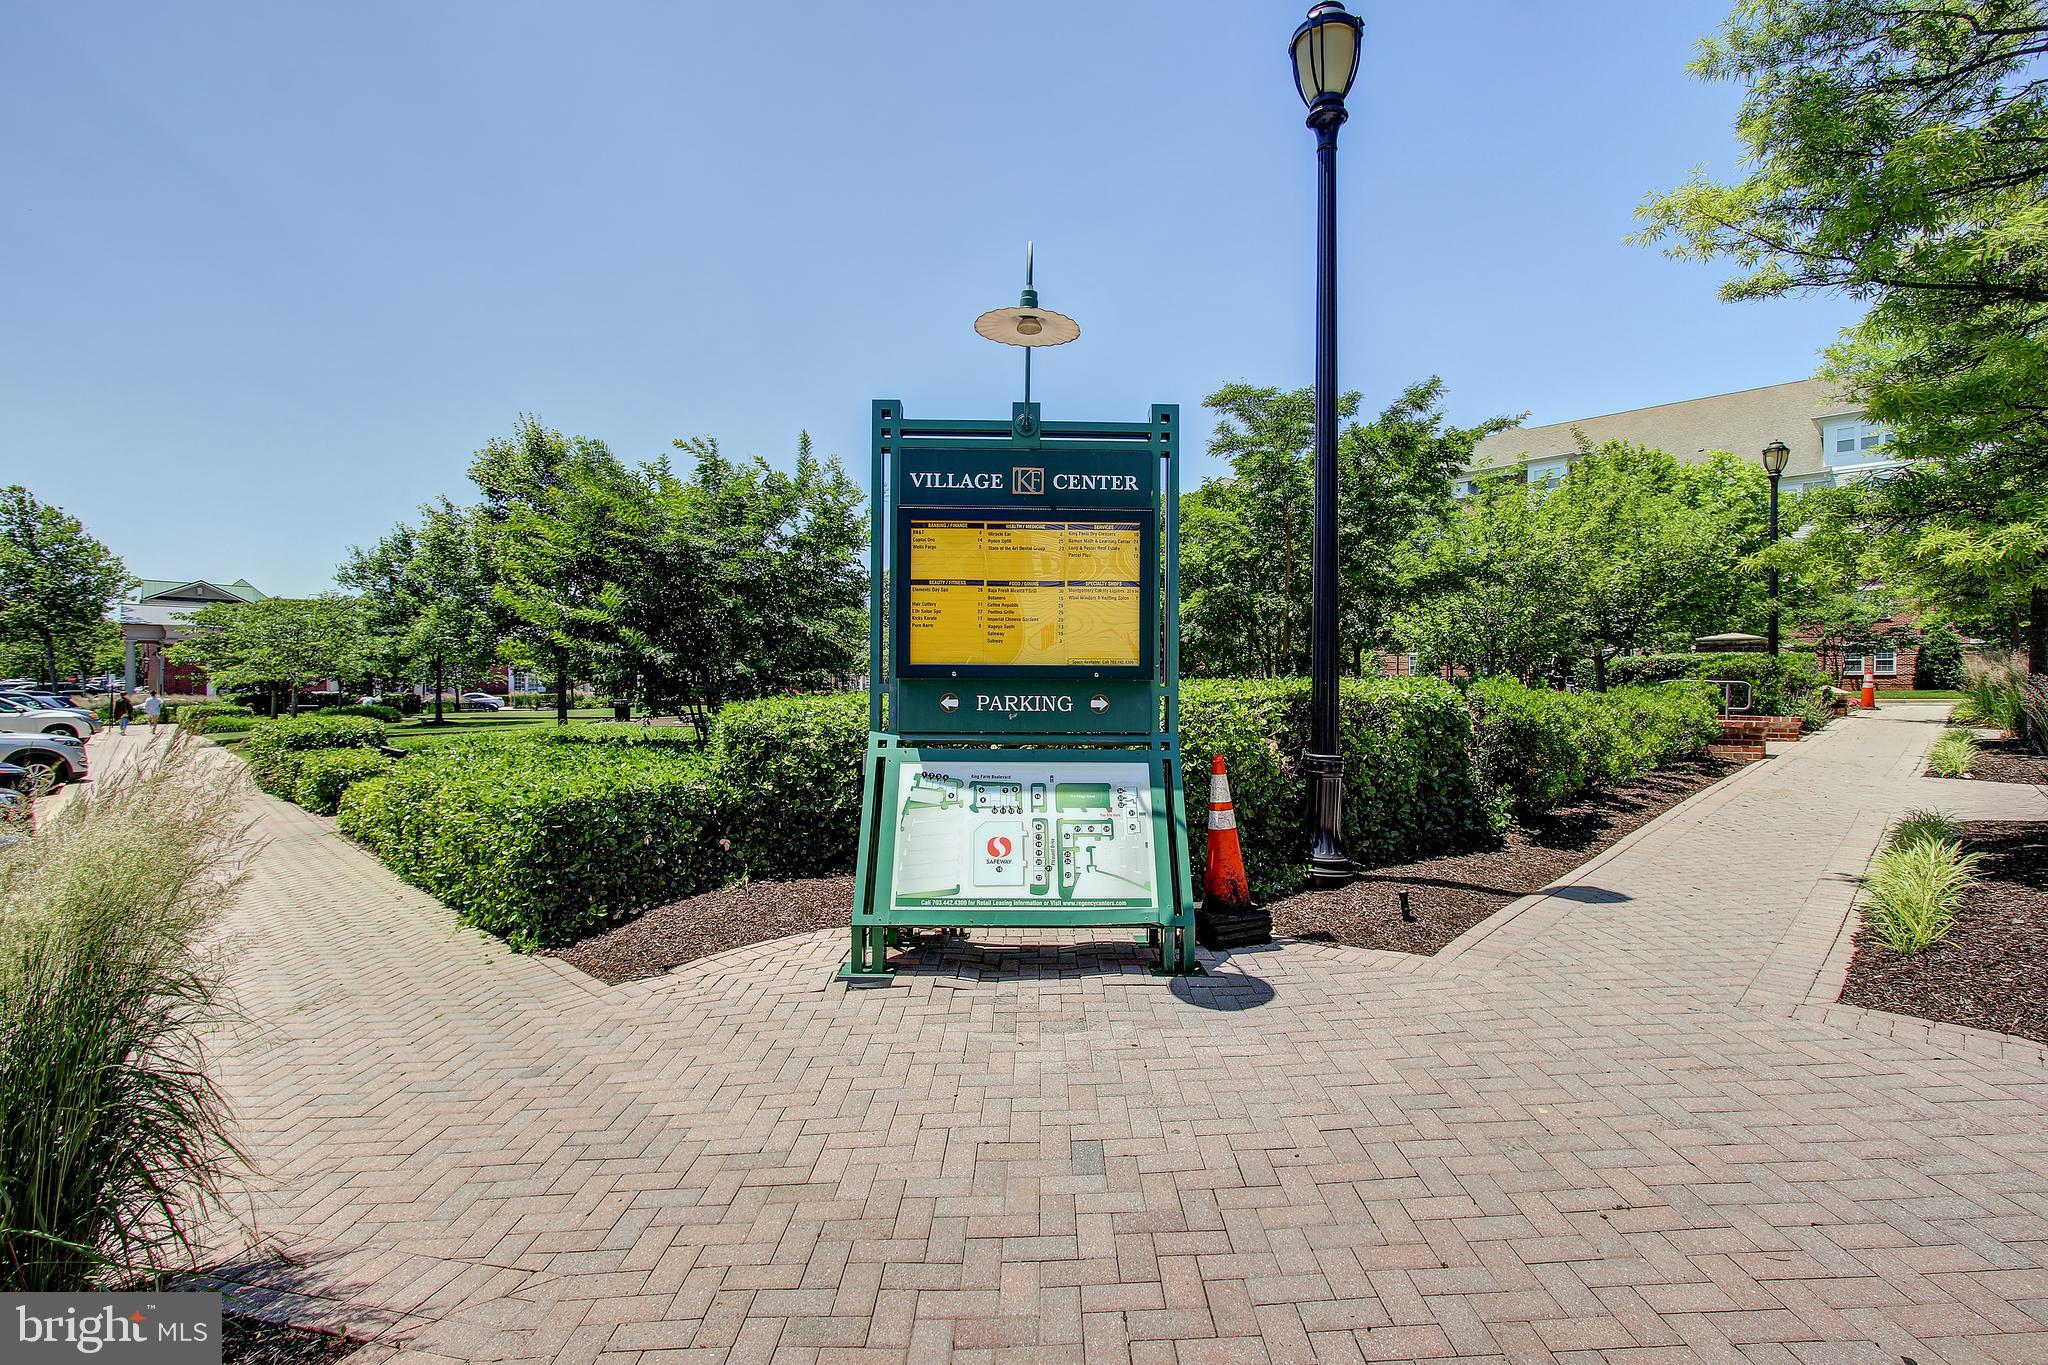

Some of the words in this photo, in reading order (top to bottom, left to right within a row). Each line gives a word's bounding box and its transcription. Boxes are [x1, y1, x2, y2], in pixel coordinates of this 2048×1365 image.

[910, 472, 1003, 489] VILLAGE
[1053, 473, 1139, 491] CENTER
[976, 695, 1073, 712] PARKING
